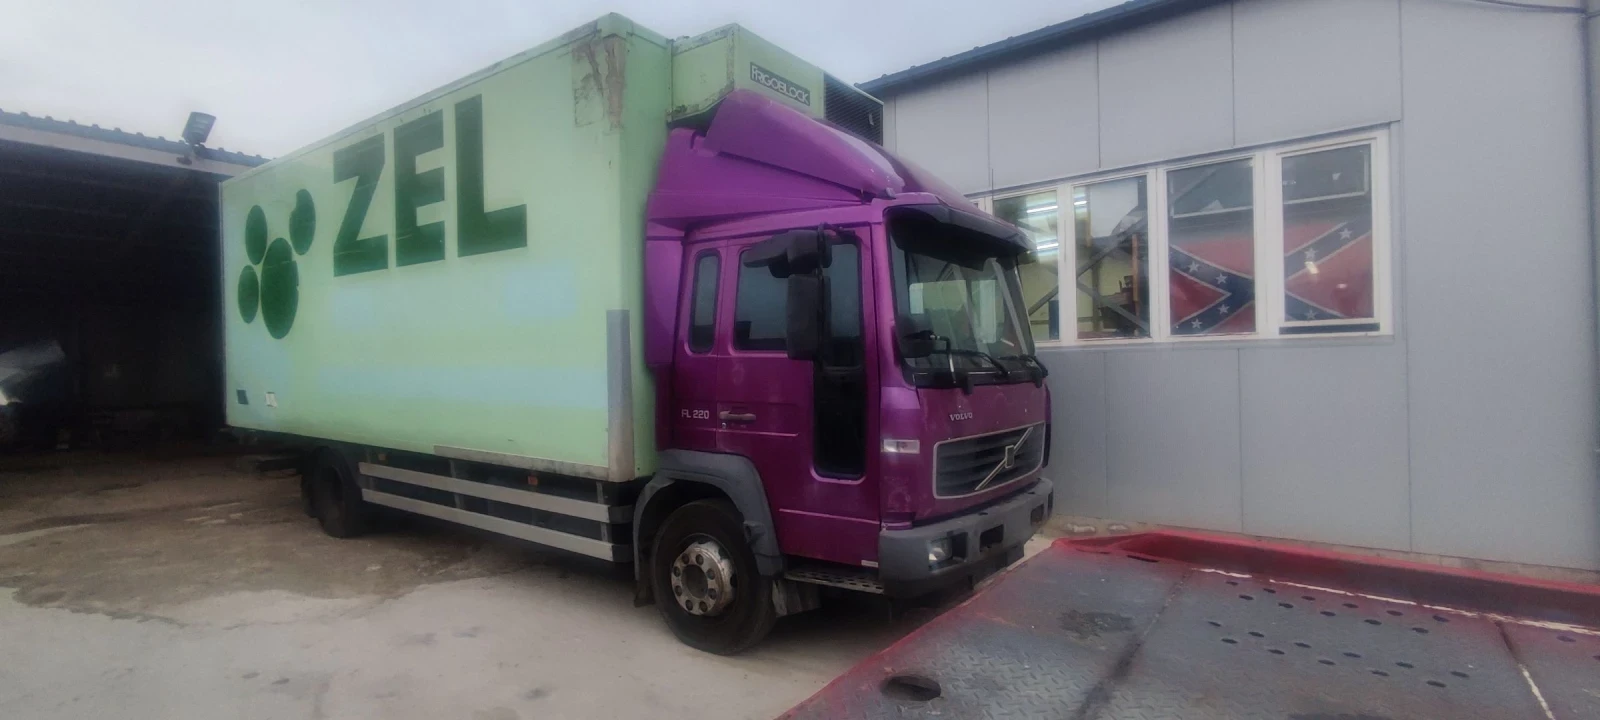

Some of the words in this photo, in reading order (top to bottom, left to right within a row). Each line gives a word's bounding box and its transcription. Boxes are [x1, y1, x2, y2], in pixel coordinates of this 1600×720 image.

[751, 64, 809, 105] FRIGOBLOCK
[333, 93, 528, 277] ZEL
[681, 409, 691, 418] FL
[692, 409, 710, 420] 220
[949, 412, 973, 421] VOLVO
